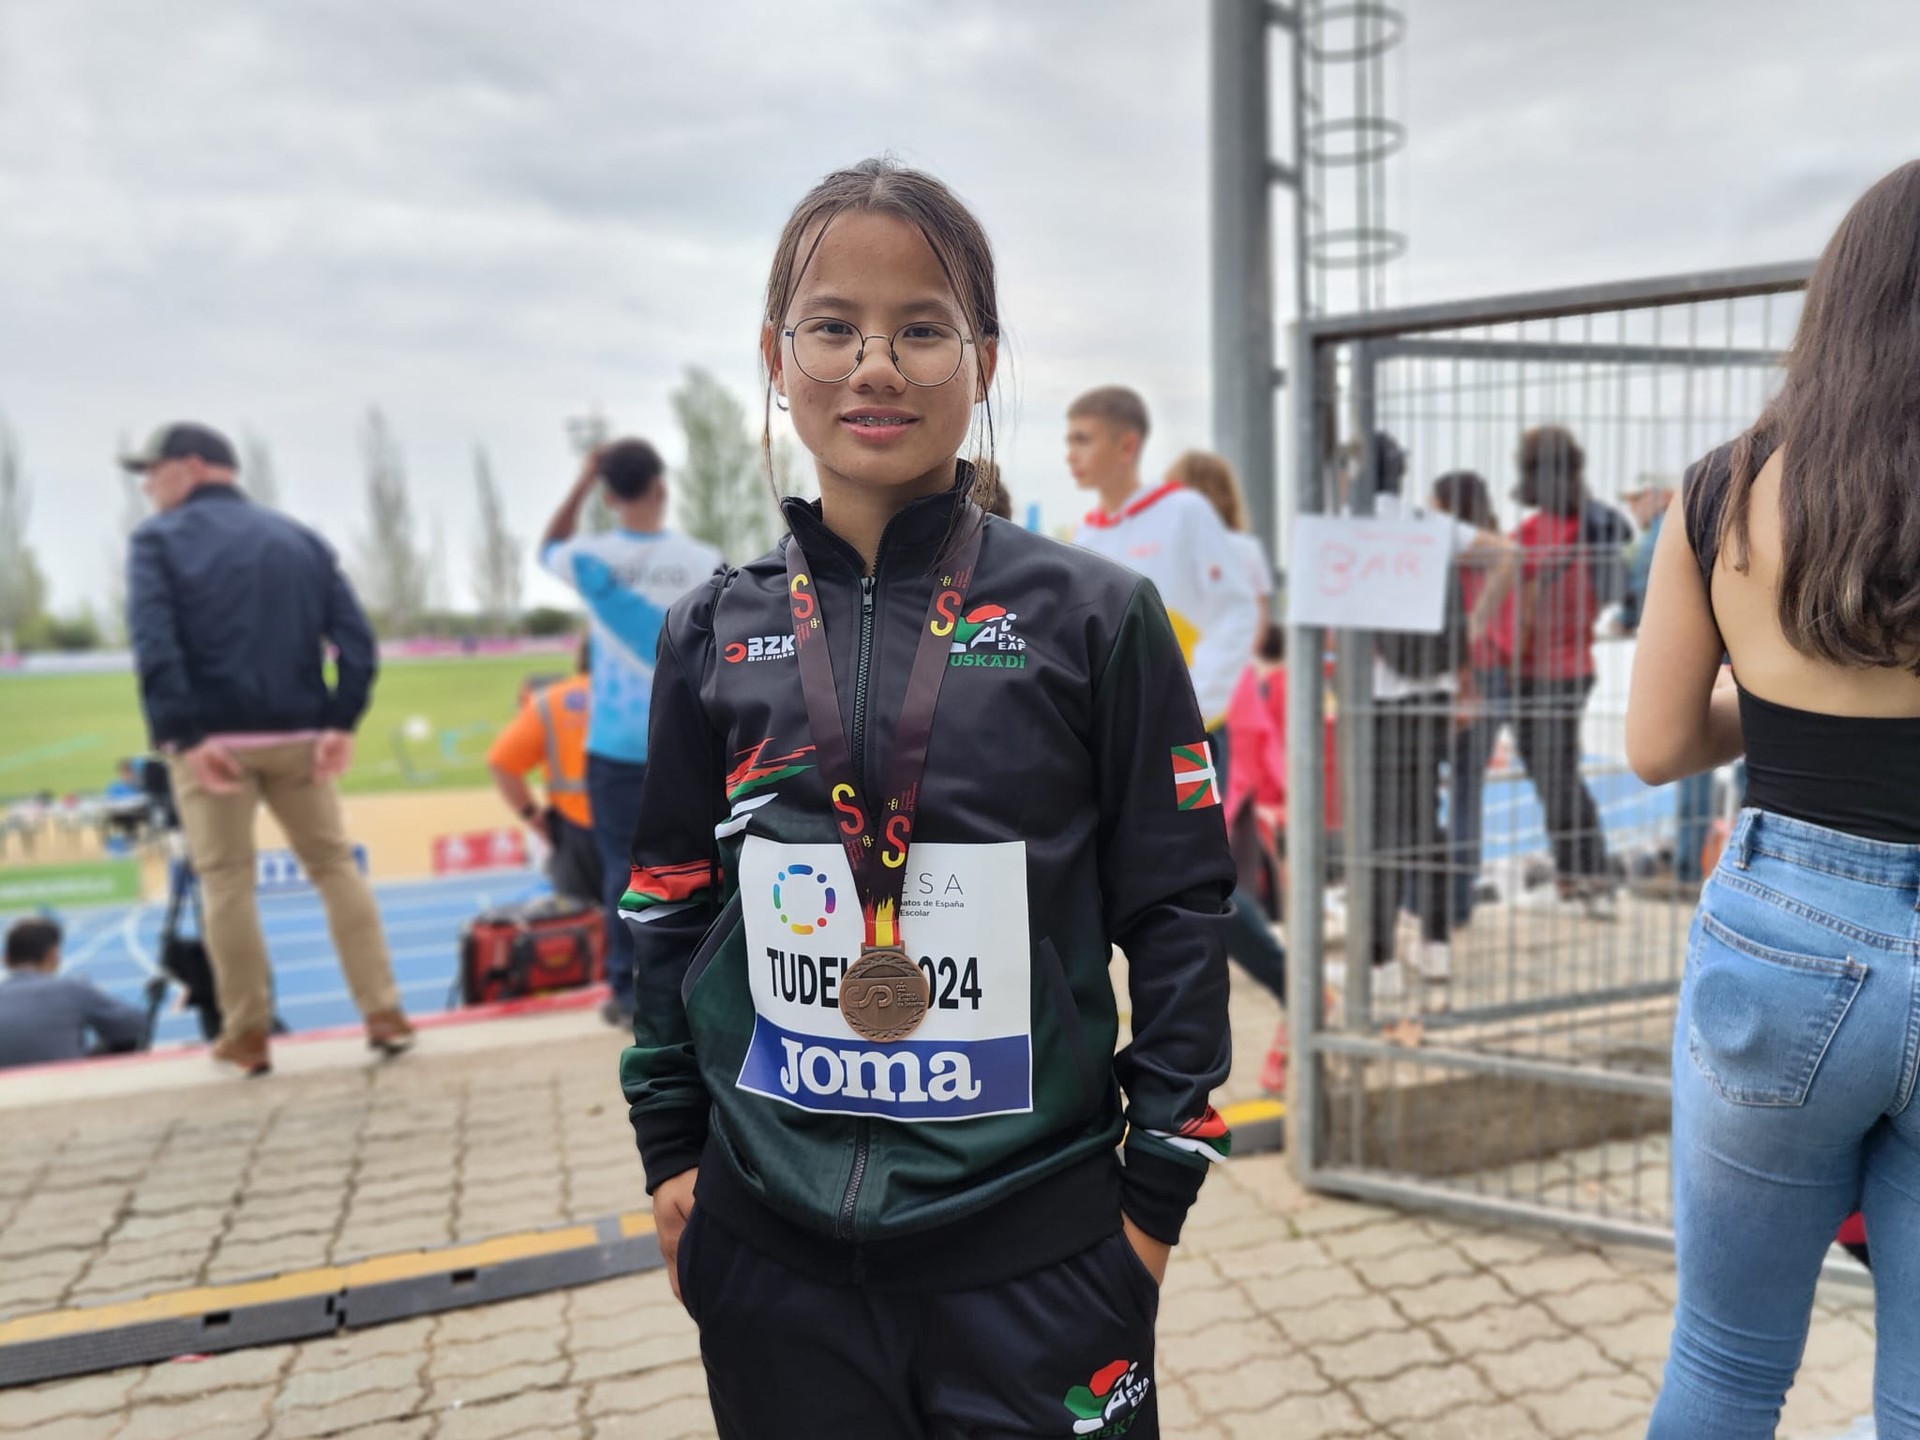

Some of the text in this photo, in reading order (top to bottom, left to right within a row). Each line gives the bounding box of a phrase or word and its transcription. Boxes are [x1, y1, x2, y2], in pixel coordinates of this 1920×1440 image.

[748, 635, 795, 656] BZK
[950, 654, 1026, 669] USKADi
[923, 899, 933, 907] de
[935, 900, 965, 908] España
[900, 909, 930, 917] Escolar
[918, 955, 982, 1010] 024
